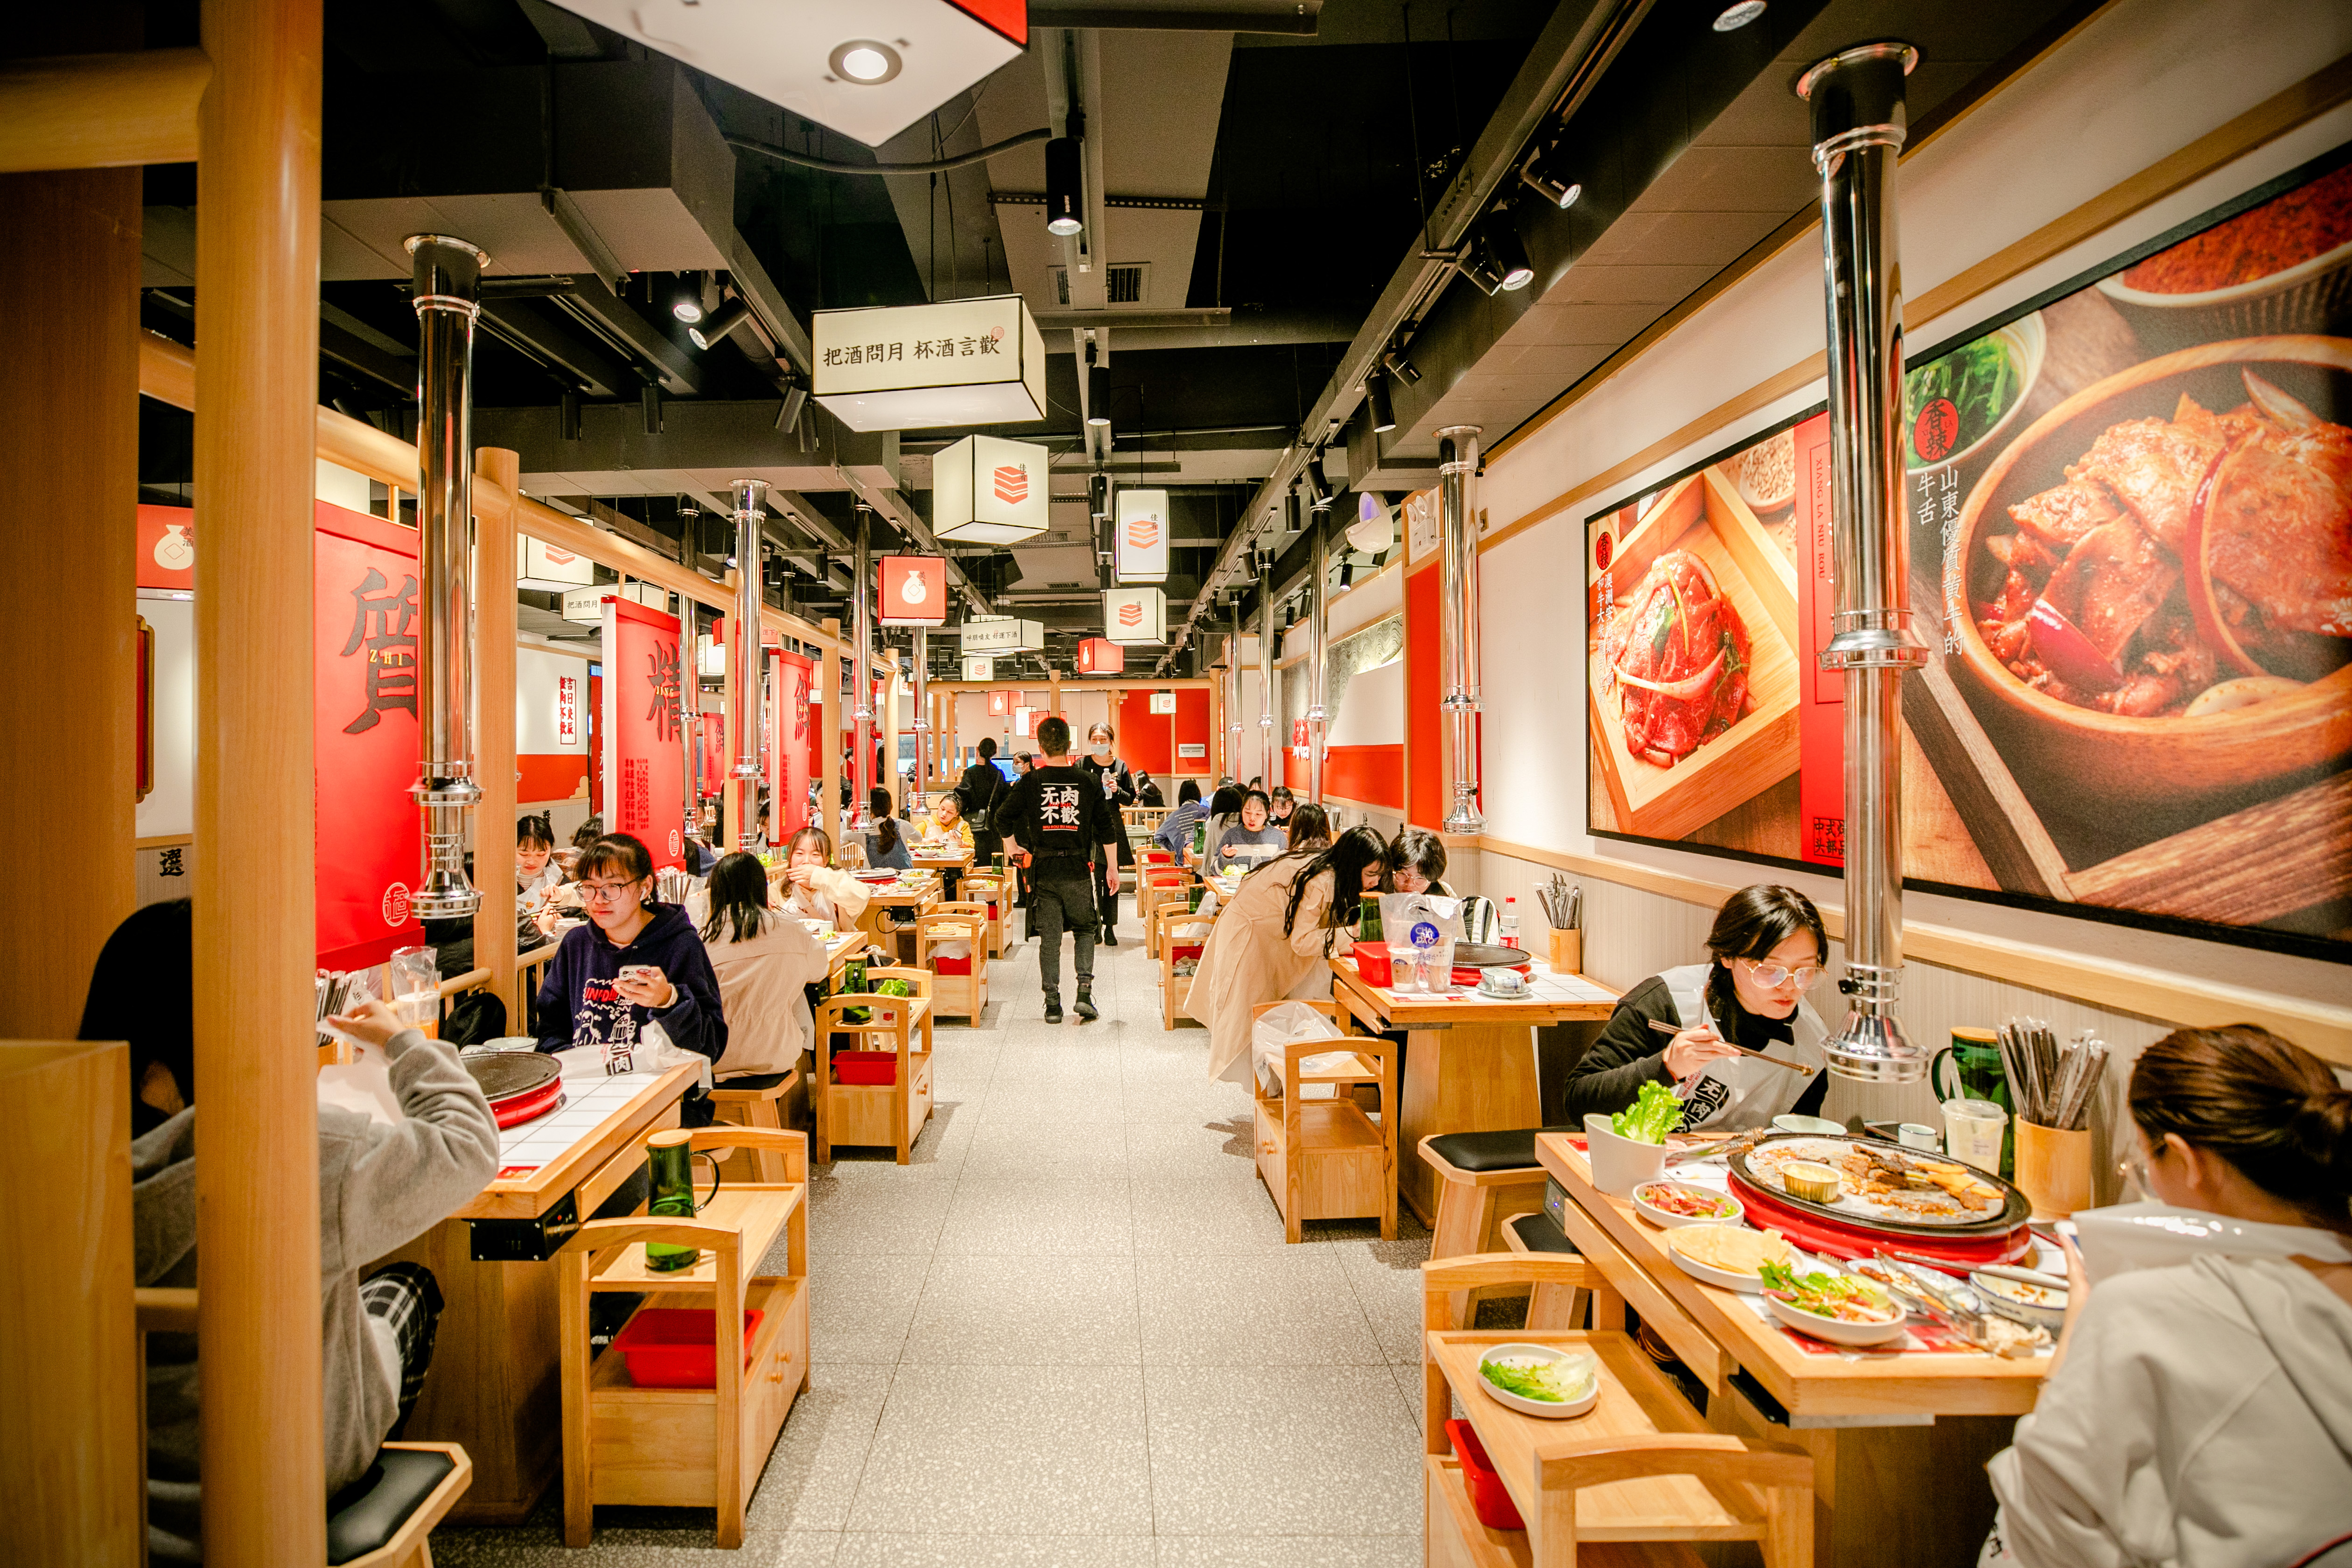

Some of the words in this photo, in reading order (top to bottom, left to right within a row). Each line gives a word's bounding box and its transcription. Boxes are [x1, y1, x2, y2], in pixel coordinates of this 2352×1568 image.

[823, 342, 903, 366] 把酒問月
[913, 335, 1001, 360] 杯酒言歡
[1924, 400, 1950, 458] 香辣
[1917, 472, 1936, 526] 牛舌
[1817, 503, 1824, 518] LA
[1150, 513, 1158, 530] 佳肴
[182, 527, 195, 547] 美酒
[918, 571, 926, 587] 美酒
[567, 600, 598, 609] 把酒問月
[369, 649, 403, 666] ZHI
[656, 686, 674, 697] JING
[1041, 786, 1079, 806] 无肉
[1040, 805, 1080, 825] 不歡
[1416, 936, 1435, 945] DAO
[614, 1056, 631, 1073] 肉
[1687, 1080, 1696, 1090] ROAST
